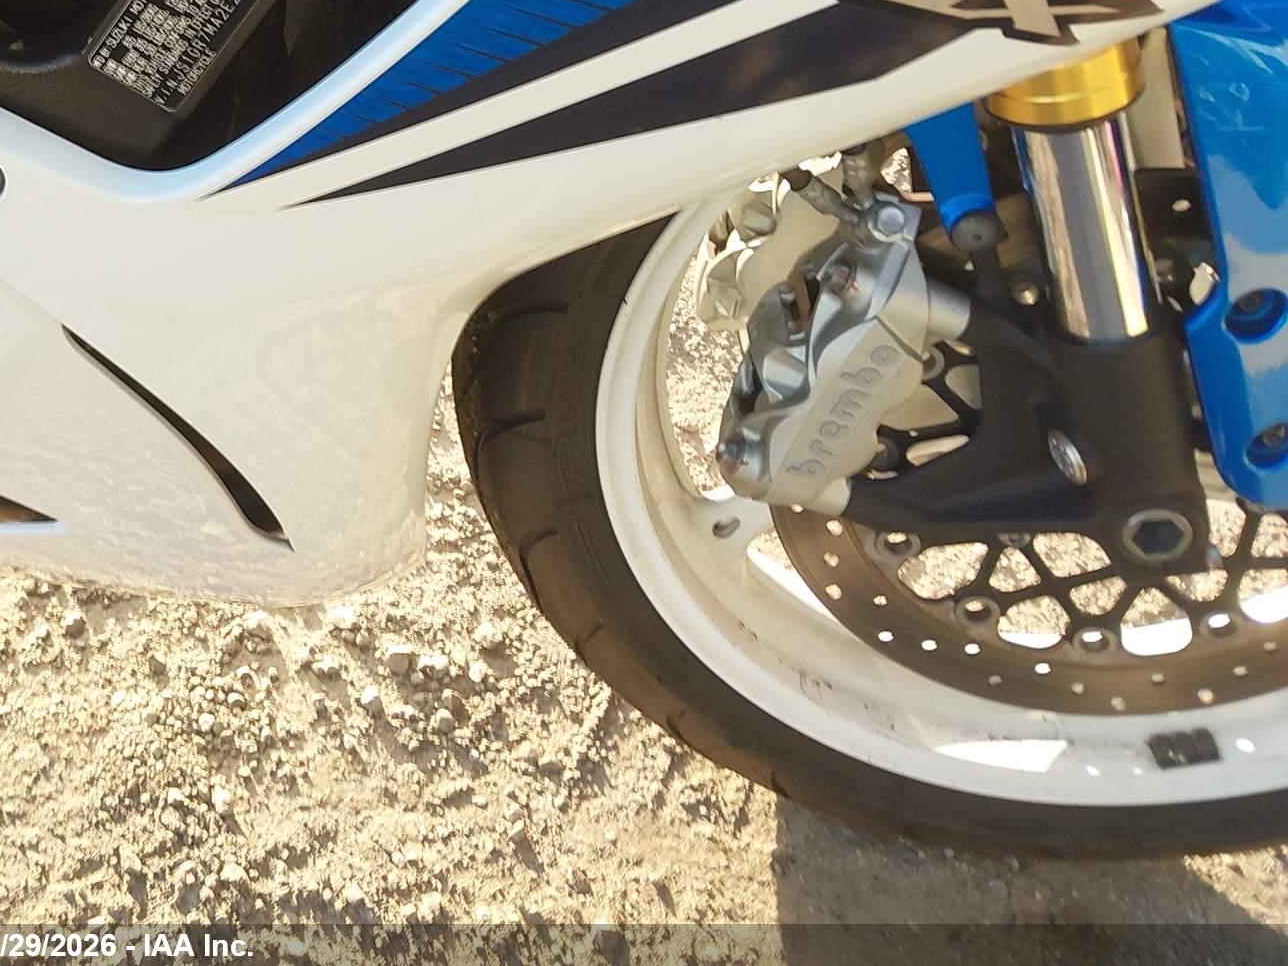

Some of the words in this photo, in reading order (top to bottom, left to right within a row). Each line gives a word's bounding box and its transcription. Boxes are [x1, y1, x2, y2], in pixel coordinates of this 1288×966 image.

[106, 16, 133, 47] SUZUKI
[142, 74, 163, 97] SAFETY
[159, 39, 188, 73] STANDARDS
[191, 5, 213, 29] EFFECT
[145, 48, 167, 74] VEHICLE
[164, 16, 191, 47] CONFORMS
[178, 48, 216, 94] MOTORCYCLE
[786, 344, 897, 477] brembo
